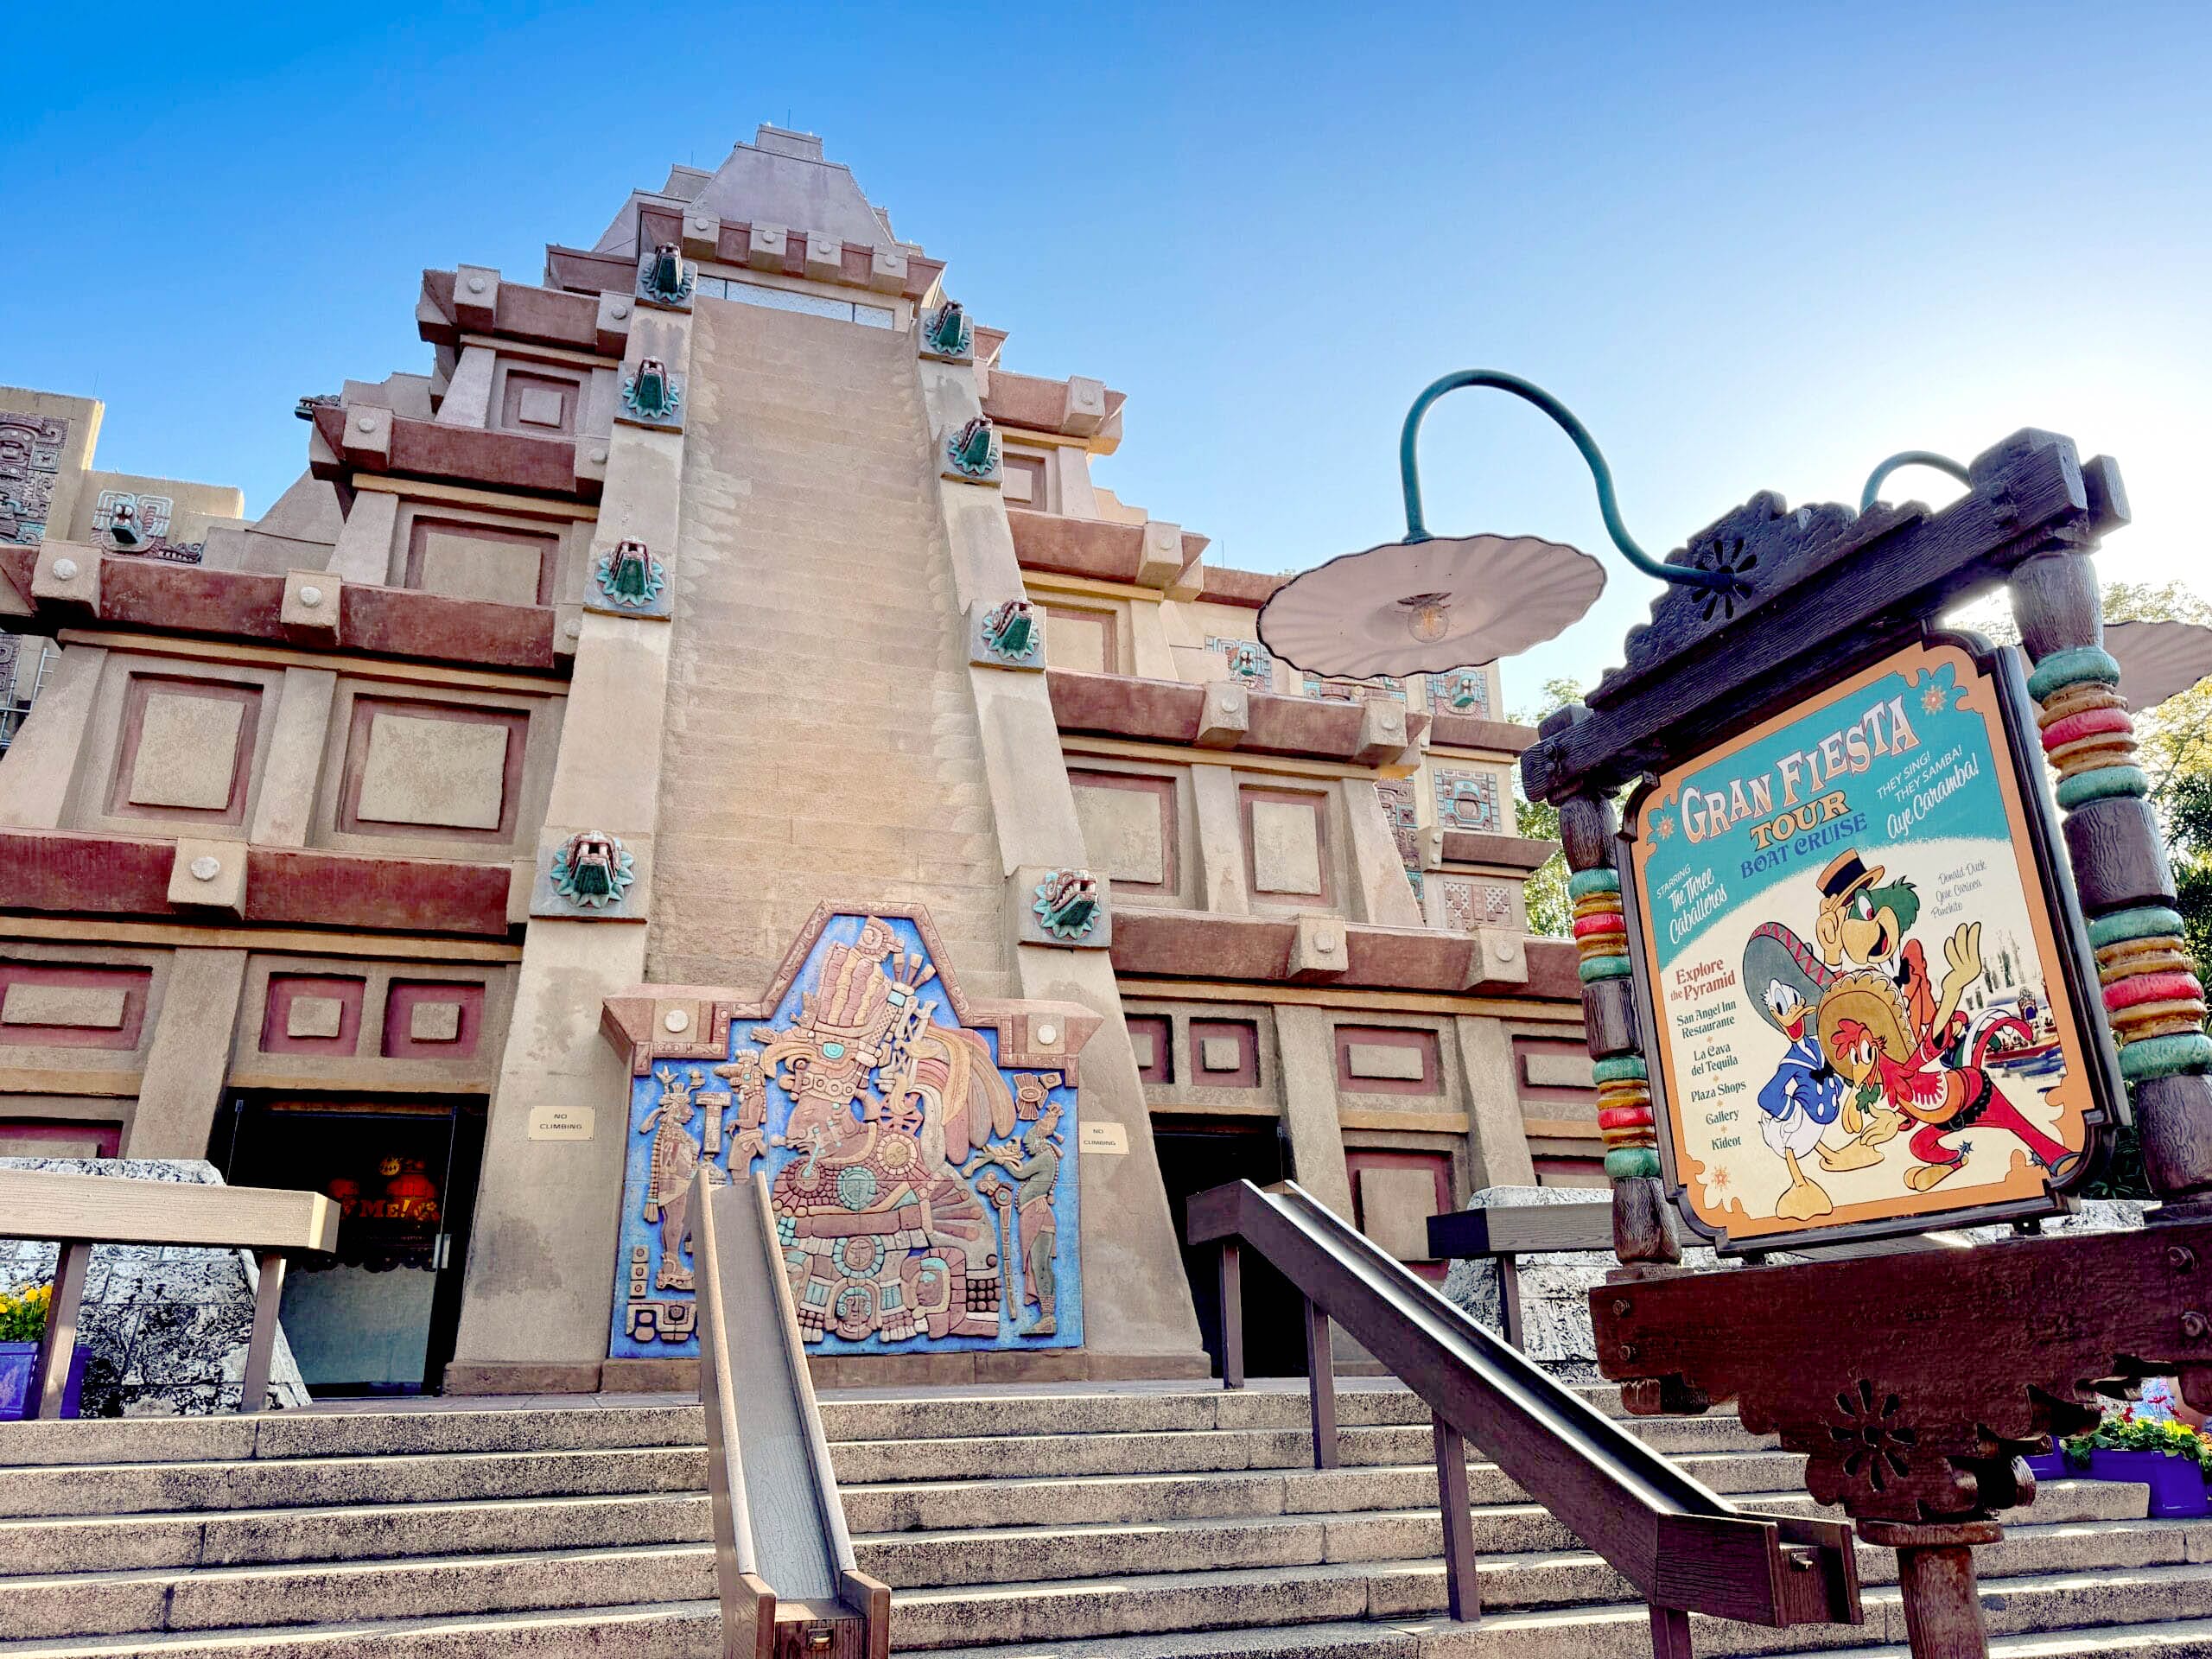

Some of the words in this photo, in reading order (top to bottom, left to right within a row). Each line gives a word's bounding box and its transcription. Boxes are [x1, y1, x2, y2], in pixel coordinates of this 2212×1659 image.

[1681, 773, 1773, 844] GRAN
[1776, 694, 1921, 808] FIESTA
[1876, 772, 1903, 799] THEY
[1904, 751, 1931, 779] SING!
[1894, 775, 1921, 803] THEY
[1922, 744, 1963, 783] SAMBA!
[1913, 752, 1979, 820] Caramba!
[1749, 790, 1852, 852] TOUR
[1740, 844, 1789, 880] BOAT
[1794, 812, 1868, 856] CRUISE
[1656, 863, 1692, 899] STARRING
[1938, 867, 1965, 885] Donald
[1966, 859, 1987, 875] Duck
[1669, 889, 1687, 912] The
[1682, 868, 1715, 904] Three
[1669, 883, 1727, 944] Caballeros
[1930, 901, 1963, 918] Panchito
[1670, 989, 1684, 1001] the
[1683, 969, 1737, 1001] Pyramid
[1675, 958, 1725, 985] Explore
[1676, 1014, 1694, 1027] San
[1695, 1003, 1721, 1021] Angel
[1722, 1000, 1737, 1013] Inn
[1681, 1015, 1736, 1039] Restaurante
[1691, 1062, 1705, 1077] del
[1706, 1054, 1739, 1072] Tequila
[1694, 1049, 1707, 1062] La
[1707, 1043, 1732, 1058] Cava
[1690, 1089, 1717, 1103] Plaza
[1717, 1080, 1747, 1096] Shops
[1705, 1109, 1740, 1126] Gallery
[1711, 1135, 1742, 1151] Kidcot
